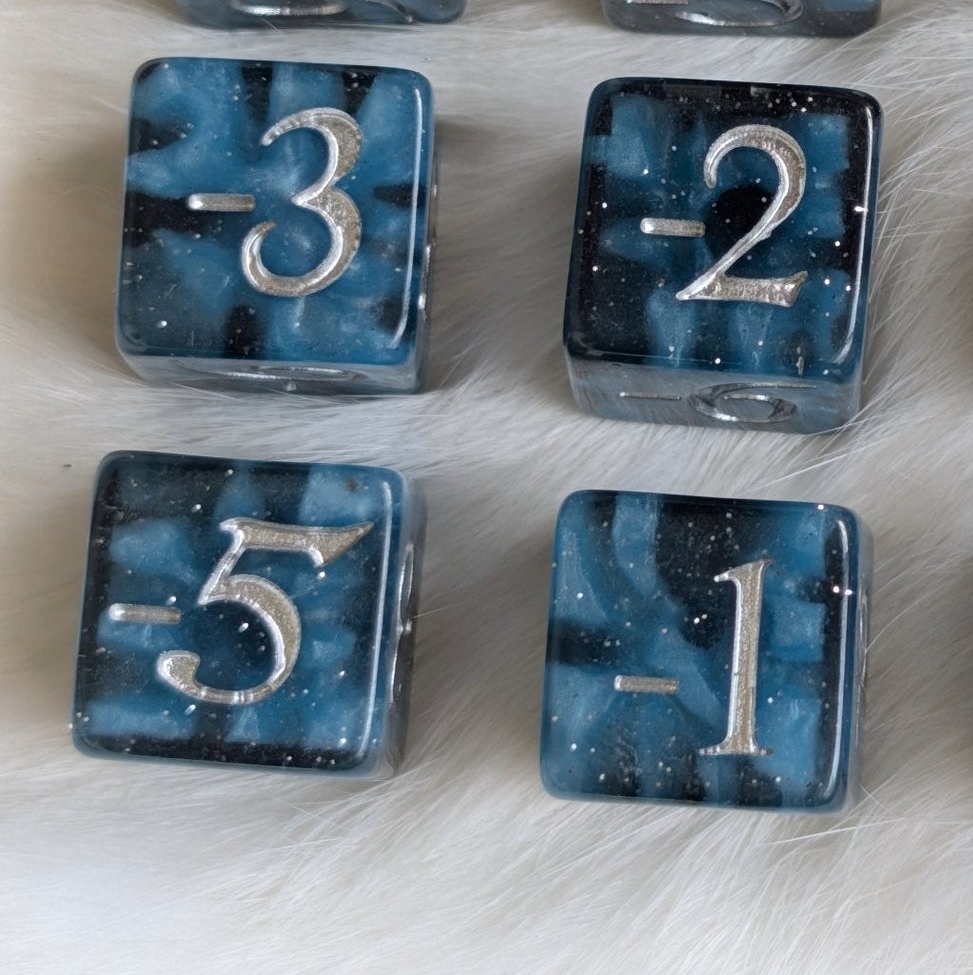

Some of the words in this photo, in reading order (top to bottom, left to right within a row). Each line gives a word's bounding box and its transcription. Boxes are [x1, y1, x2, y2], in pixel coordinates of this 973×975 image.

[187, 106, 364, 297] -3
[640, 123, 810, 308] -2
[107, 516, 375, 705] -5
